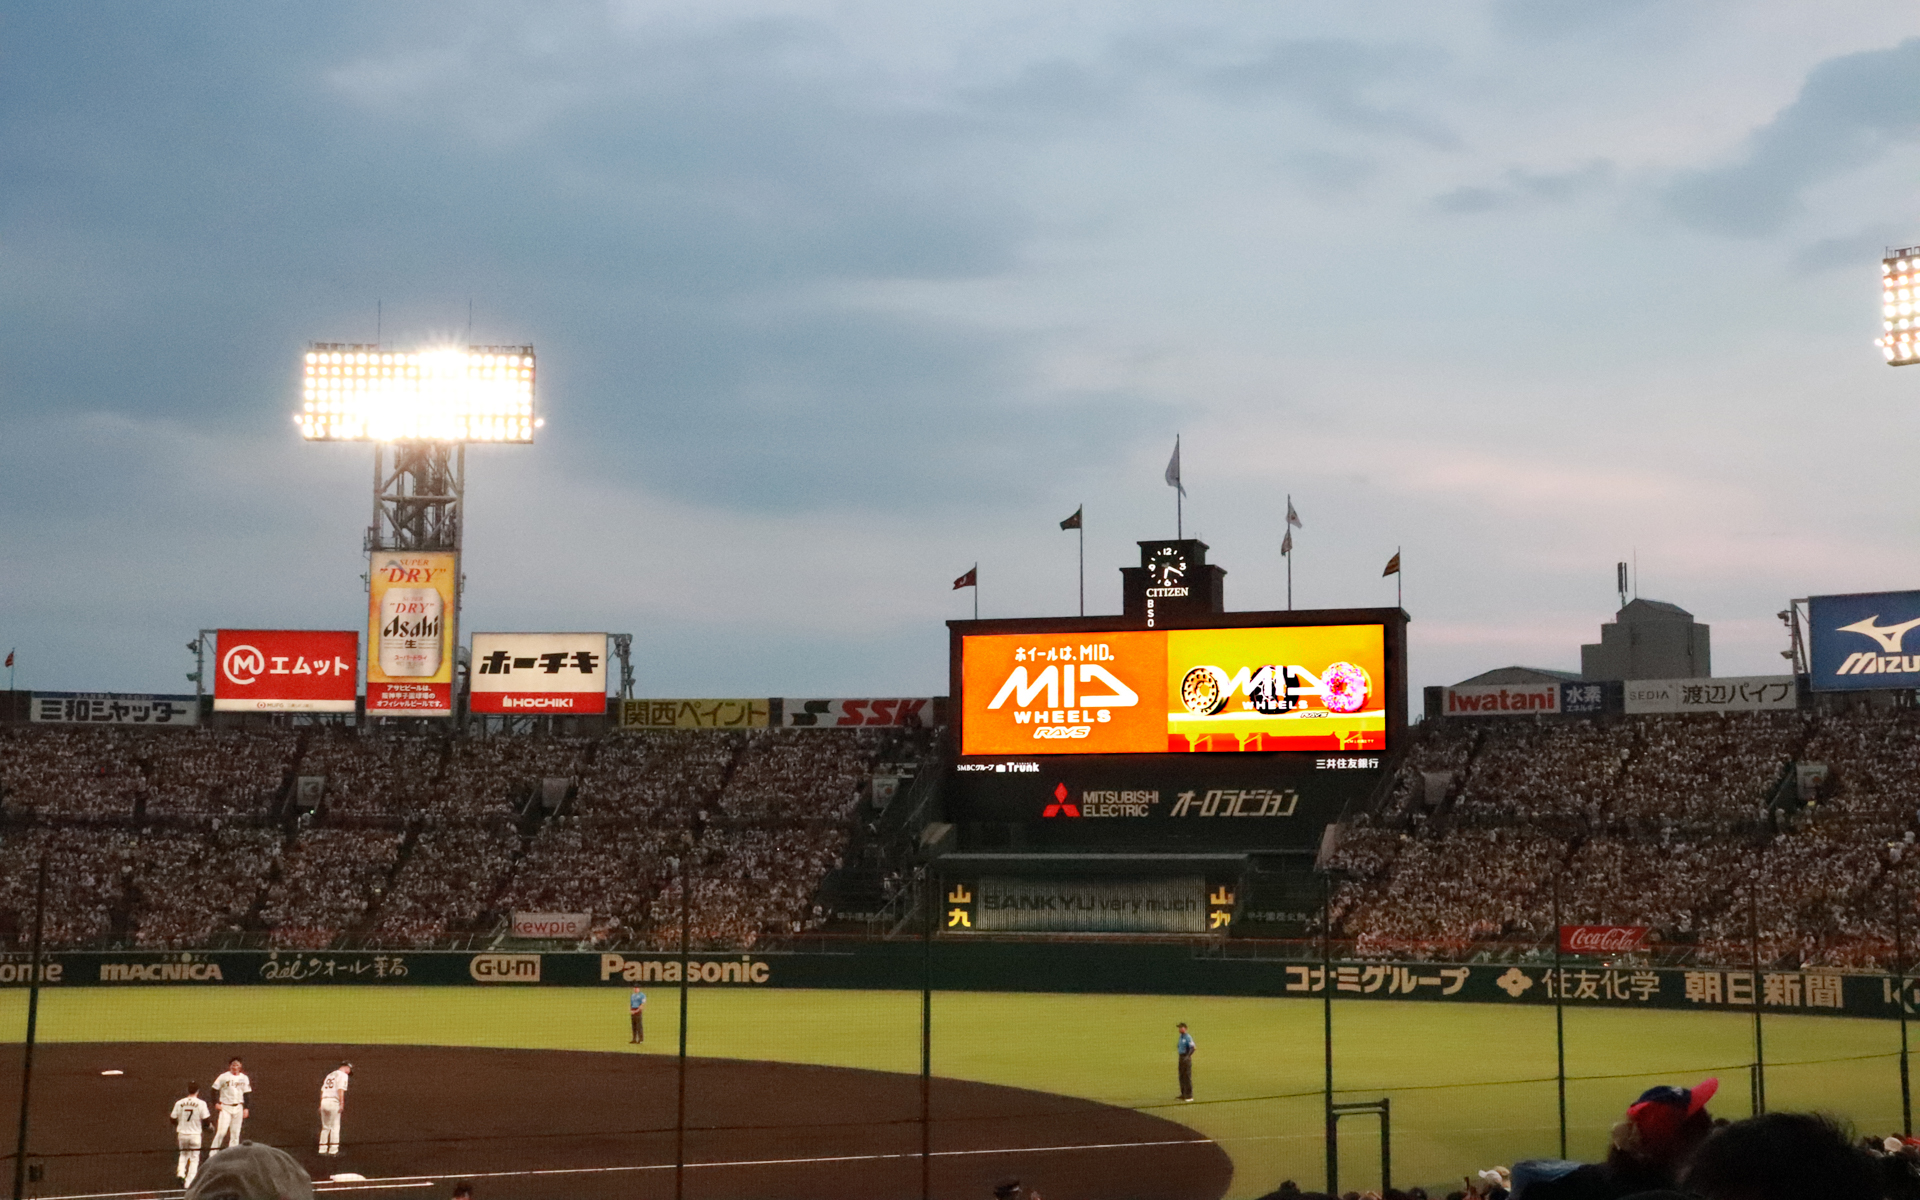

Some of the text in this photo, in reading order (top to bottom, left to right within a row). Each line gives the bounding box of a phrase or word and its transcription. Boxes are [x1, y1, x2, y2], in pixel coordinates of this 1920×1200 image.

[1163, 547, 1172, 555] 12
[1148, 563, 1156, 571] 9
[1179, 563, 1187, 571] 3
[1146, 587, 1189, 597] CITIZEN
[1164, 579, 1171, 587] 6
[383, 614, 439, 637] Asahi
[405, 639, 417, 649] 生
[270, 656, 350, 676] エムット
[479, 650, 599, 674] ホーチキ
[987, 664, 1139, 709] MID
[1566, 685, 1602, 704] 水素
[1682, 680, 1794, 705] 渡辺パイプ
[513, 698, 573, 708] HOCHIKI
[1242, 700, 1309, 710] WHEELS
[1448, 687, 1555, 712] Iwatani
[40, 700, 187, 722] 三和シャッター
[623, 700, 767, 727] 関西ペイント
[836, 700, 928, 727] SSK
[1014, 710, 1111, 724] WHEELS
[1033, 726, 1091, 739] RAYS
[1007, 762, 1040, 772] Trunk
[1316, 758, 1379, 769] 三井住友銀行
[1083, 791, 1159, 804] MITSUBISHI
[1170, 788, 1300, 817] オーロラビジョン
[1083, 804, 1149, 817] ELECTRIC
[984, 895, 1095, 910] SANKYU
[513, 916, 576, 936] kewpie
[1570, 927, 1636, 951] Coca-Cola
[308, 955, 408, 978] クオール薬局
[601, 953, 770, 983] Panasonic
[1286, 965, 1470, 995] コナミグループ
[1541, 968, 1661, 1001] 住友化学
[1684, 971, 1844, 1009] 朝日新聞
[184, 1109, 194, 1122] 7
